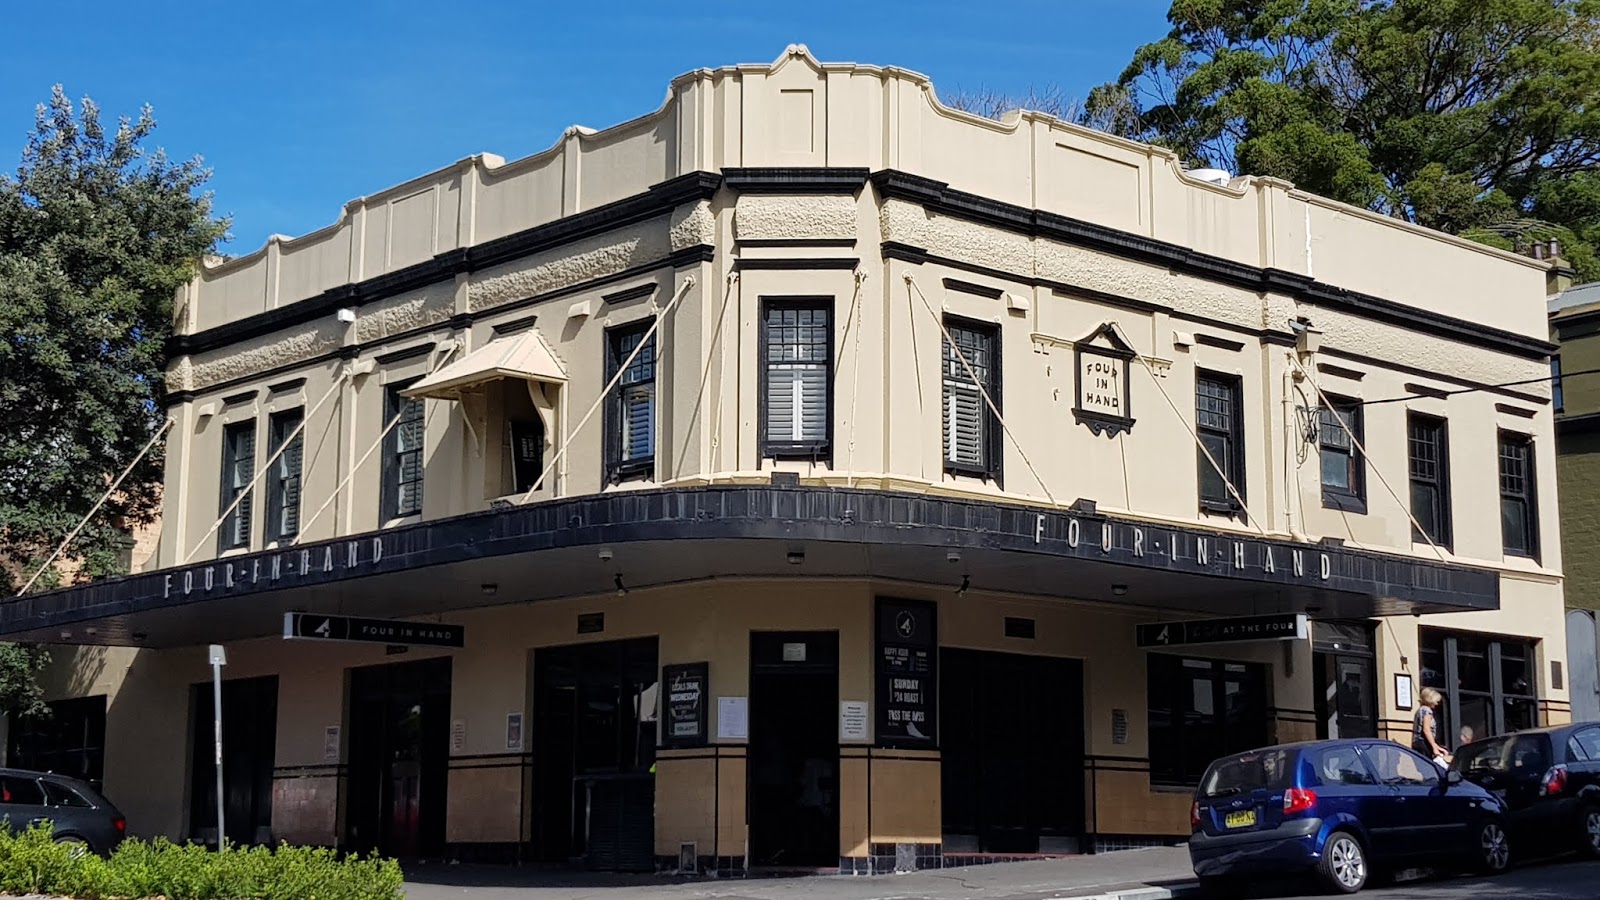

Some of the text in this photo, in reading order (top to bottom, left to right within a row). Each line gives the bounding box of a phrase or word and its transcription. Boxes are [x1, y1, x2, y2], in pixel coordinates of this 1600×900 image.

[1087, 363, 1117, 377] FOUR
[1096, 378, 1108, 389] IN
[1086, 392, 1119, 408] HAND
[1034, 513, 1331, 580] FOUR IN HAND
[164, 538, 384, 599] FOUR IN HAND
[362, 626, 452, 640] FOUR IN HAND
[1223, 626, 1235, 634] AT
[1241, 624, 1260, 632] THE
[1266, 622, 1294, 631] FOUR
[894, 678, 919, 690] SUNDAY
[903, 692, 919, 703] ROAST
